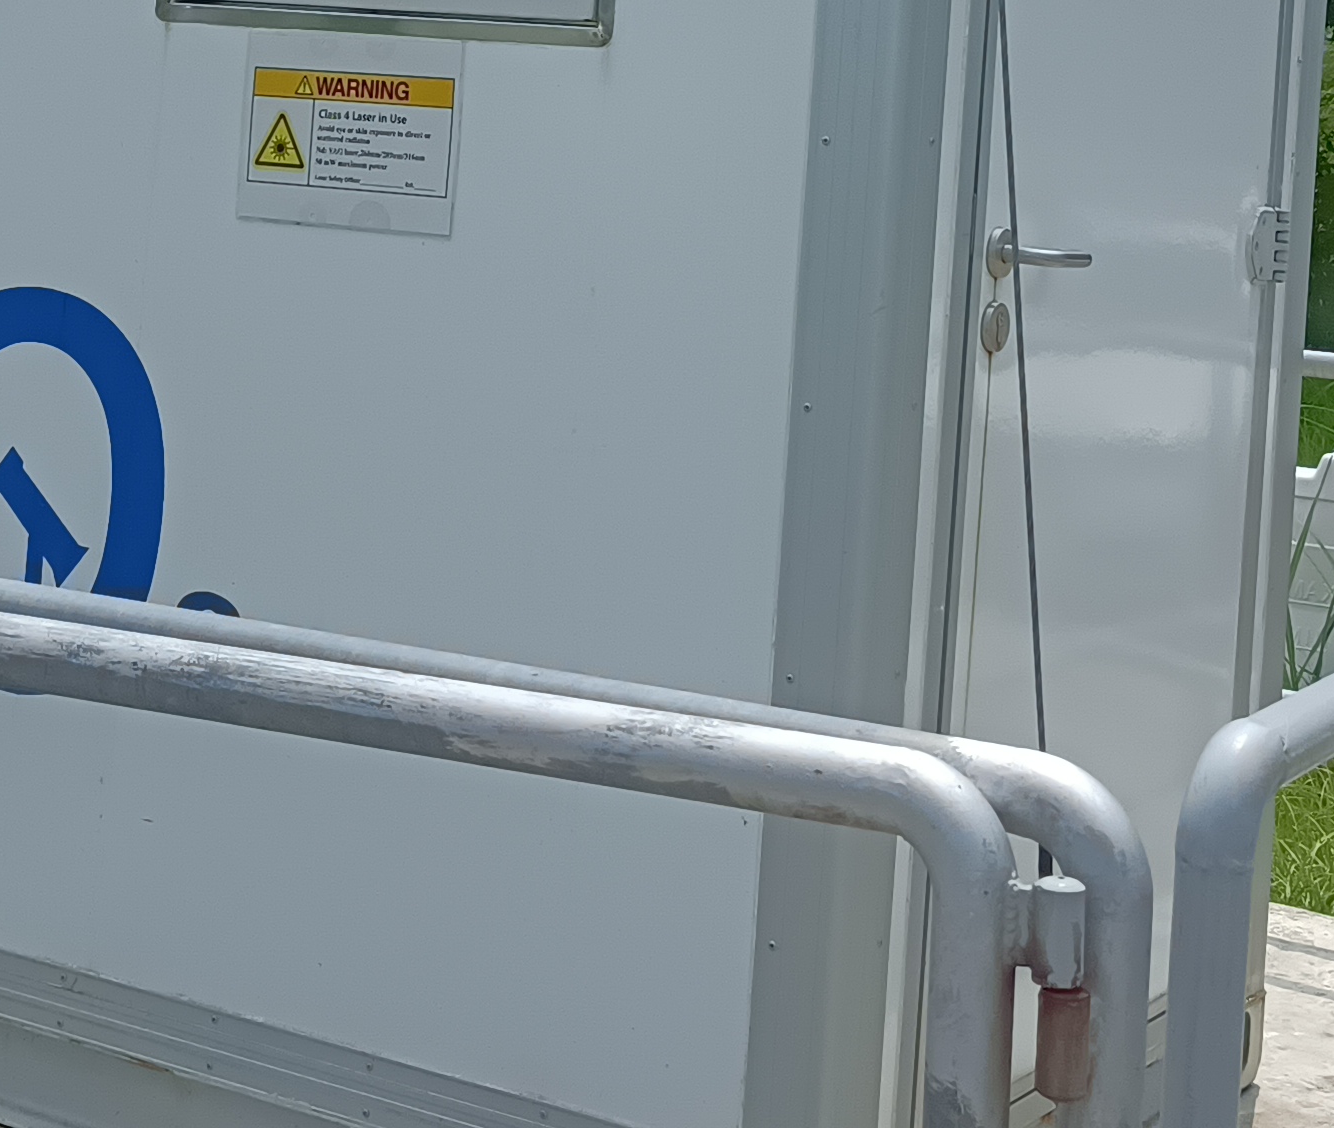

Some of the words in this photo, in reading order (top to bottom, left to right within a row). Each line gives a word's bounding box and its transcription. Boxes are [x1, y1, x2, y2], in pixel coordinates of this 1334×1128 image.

[315, 76, 410, 101] WARNING
[318, 108, 342, 120] Class
[344, 110, 350, 120] 4
[352, 110, 376, 122] Laser
[378, 111, 388, 123] in
[390, 113, 408, 125] Use
